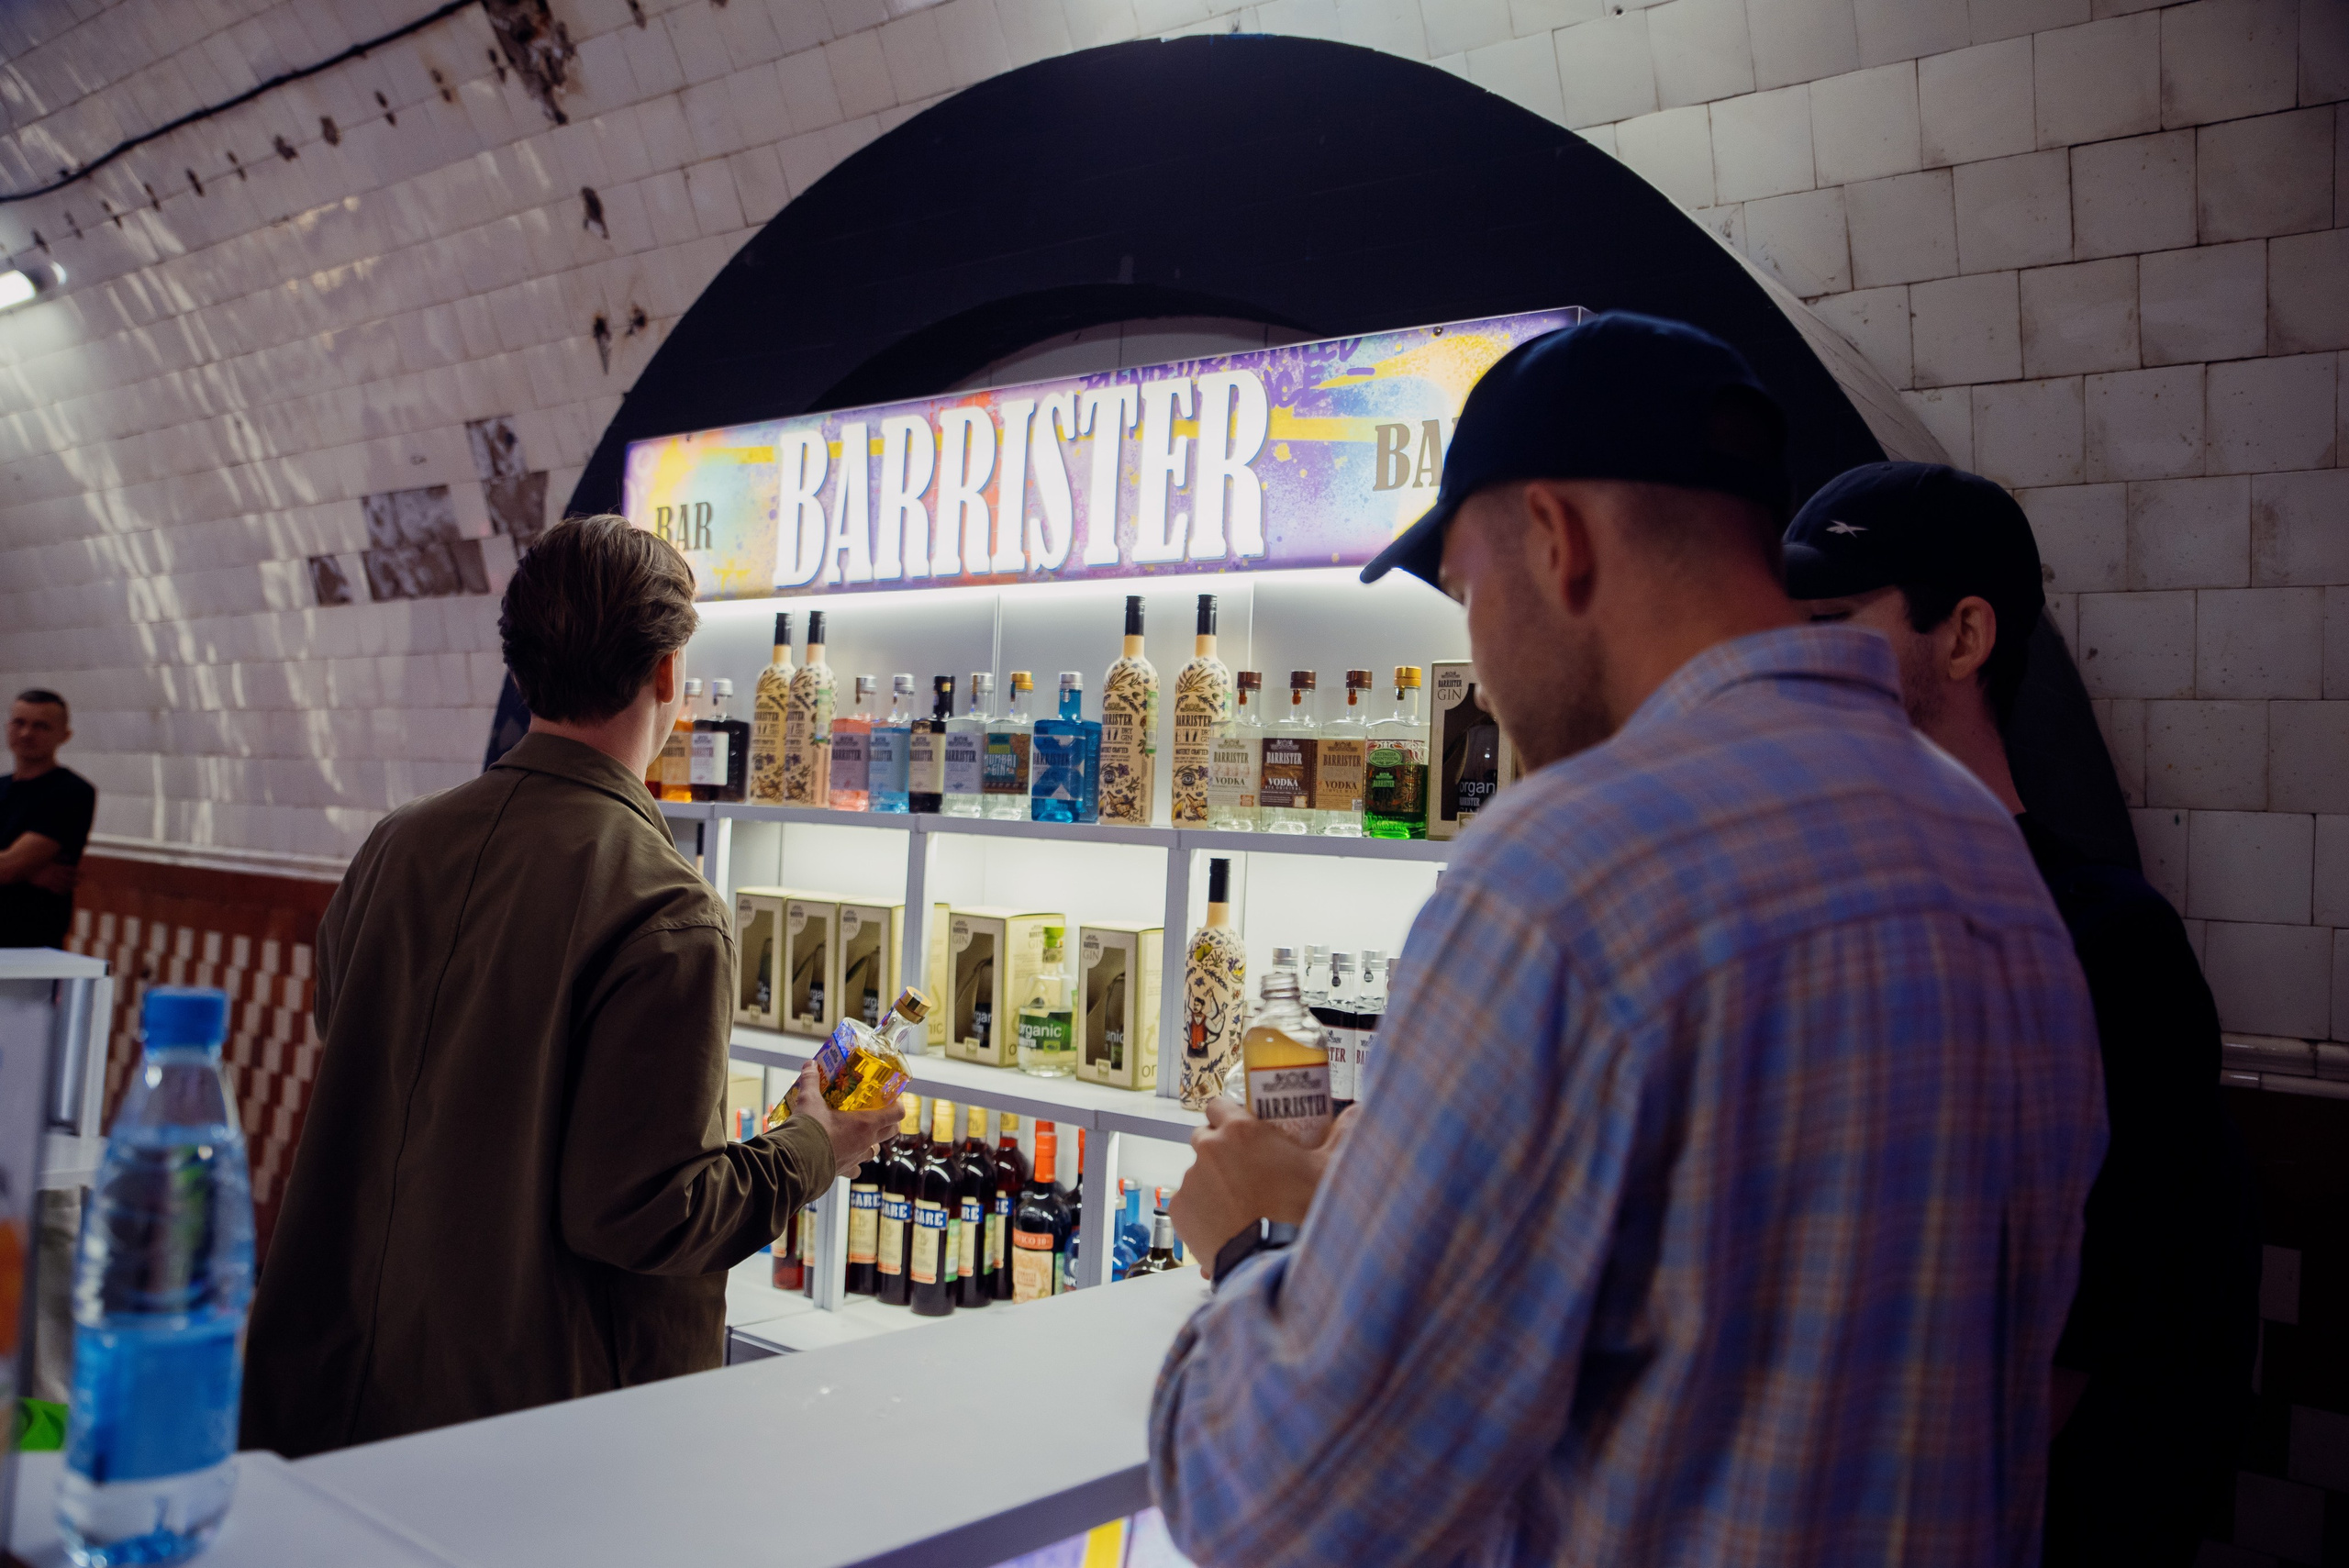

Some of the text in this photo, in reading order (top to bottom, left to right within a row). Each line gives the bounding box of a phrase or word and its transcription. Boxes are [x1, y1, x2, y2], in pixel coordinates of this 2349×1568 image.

[1373, 416, 1461, 492] BA
[773, 369, 1270, 589] BARRISTER
[1438, 679, 1462, 688] BARRISTER
[1437, 688, 1463, 701] GIN
[1214, 751, 1249, 764] BARRISTER
[1266, 751, 1302, 765] BARRISTER
[1323, 754, 1362, 767] BARRISTER
[991, 764, 1006, 776] GIN
[1216, 777, 1245, 785] VODKA
[1268, 777, 1298, 787] VODKA
[1325, 781, 1358, 790] VODKA
[1083, 951, 1100, 961] GIN
[1019, 1023, 1063, 1040] organic
